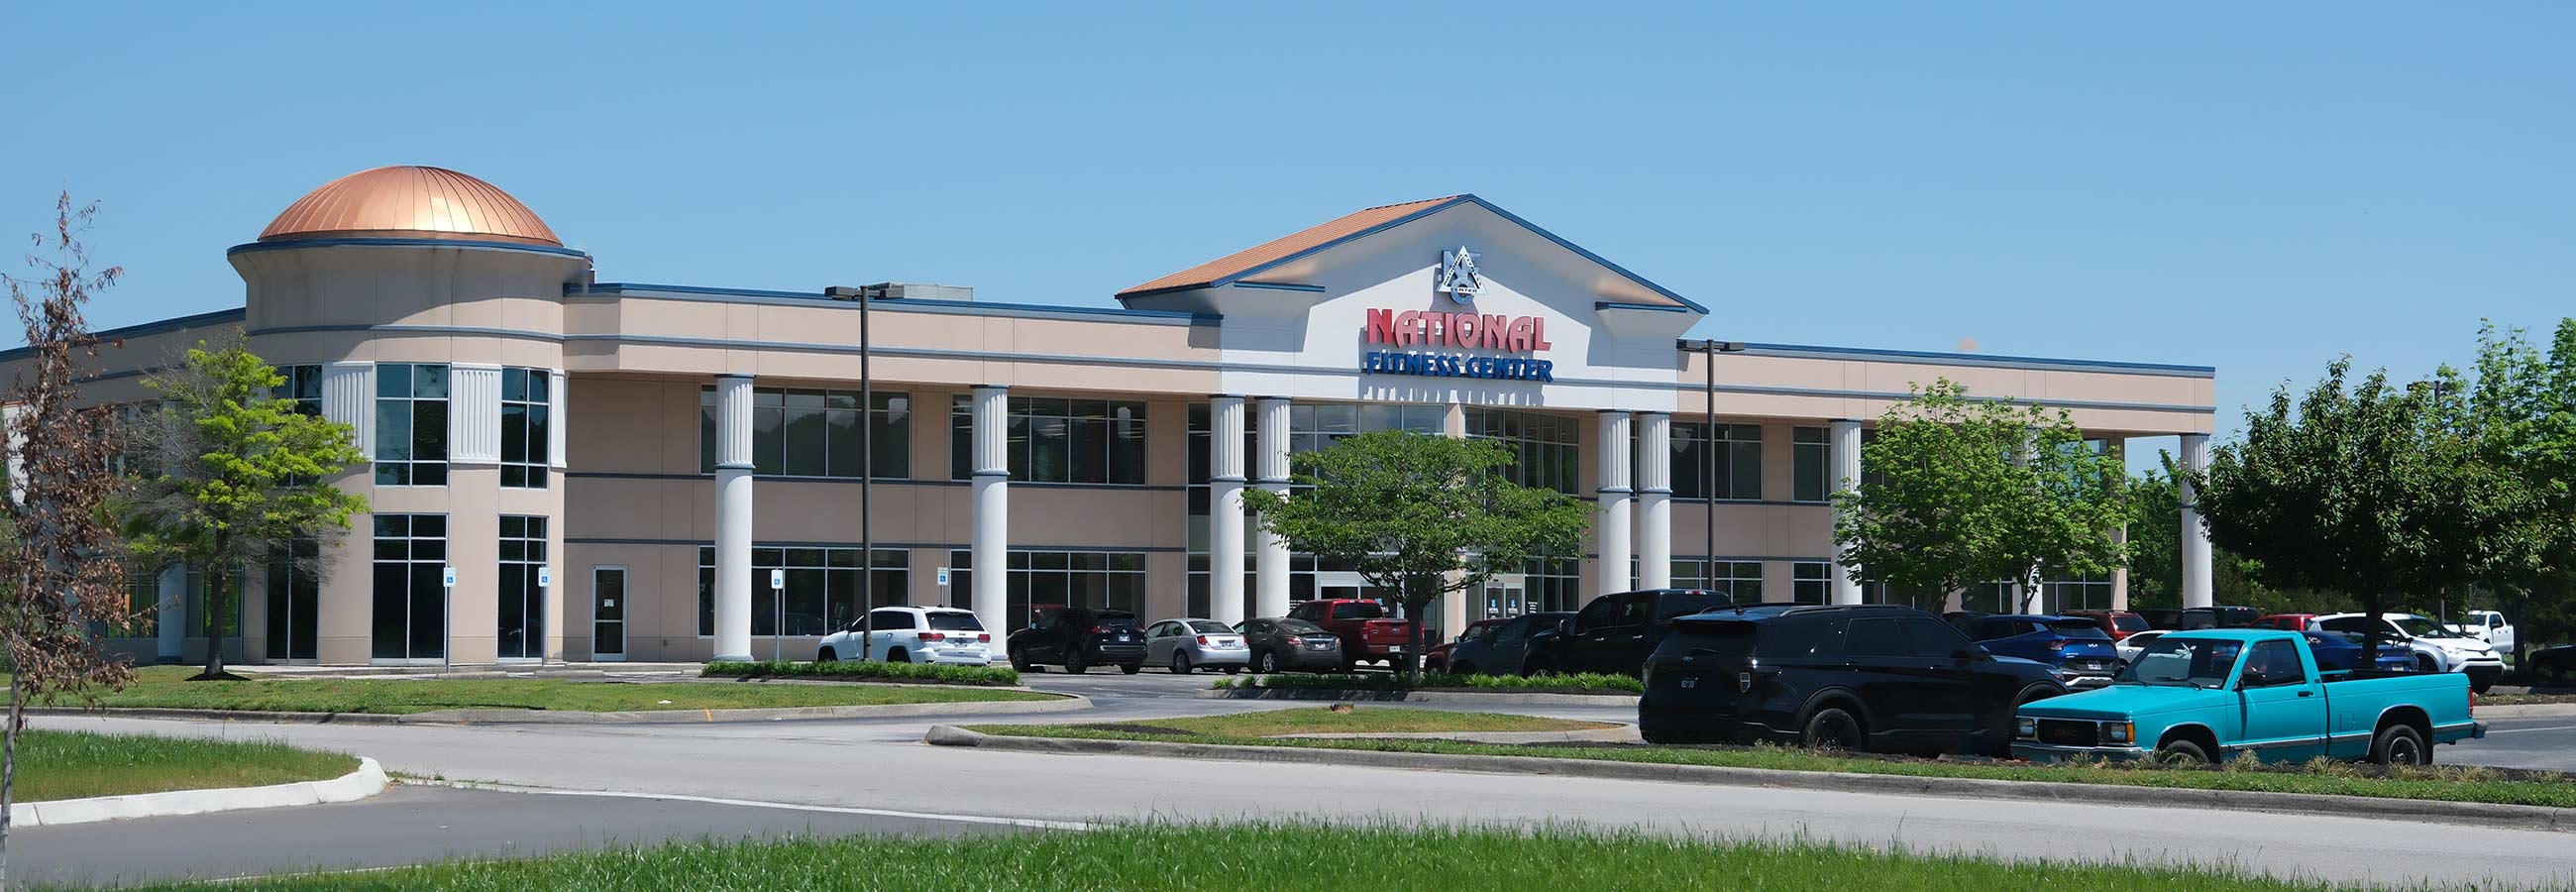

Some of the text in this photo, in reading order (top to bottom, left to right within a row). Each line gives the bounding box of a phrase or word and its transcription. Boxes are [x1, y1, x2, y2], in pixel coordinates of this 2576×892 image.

[1367, 308, 1553, 354] NATIONAL
[1367, 351, 1554, 383] FITNESS CENTER
